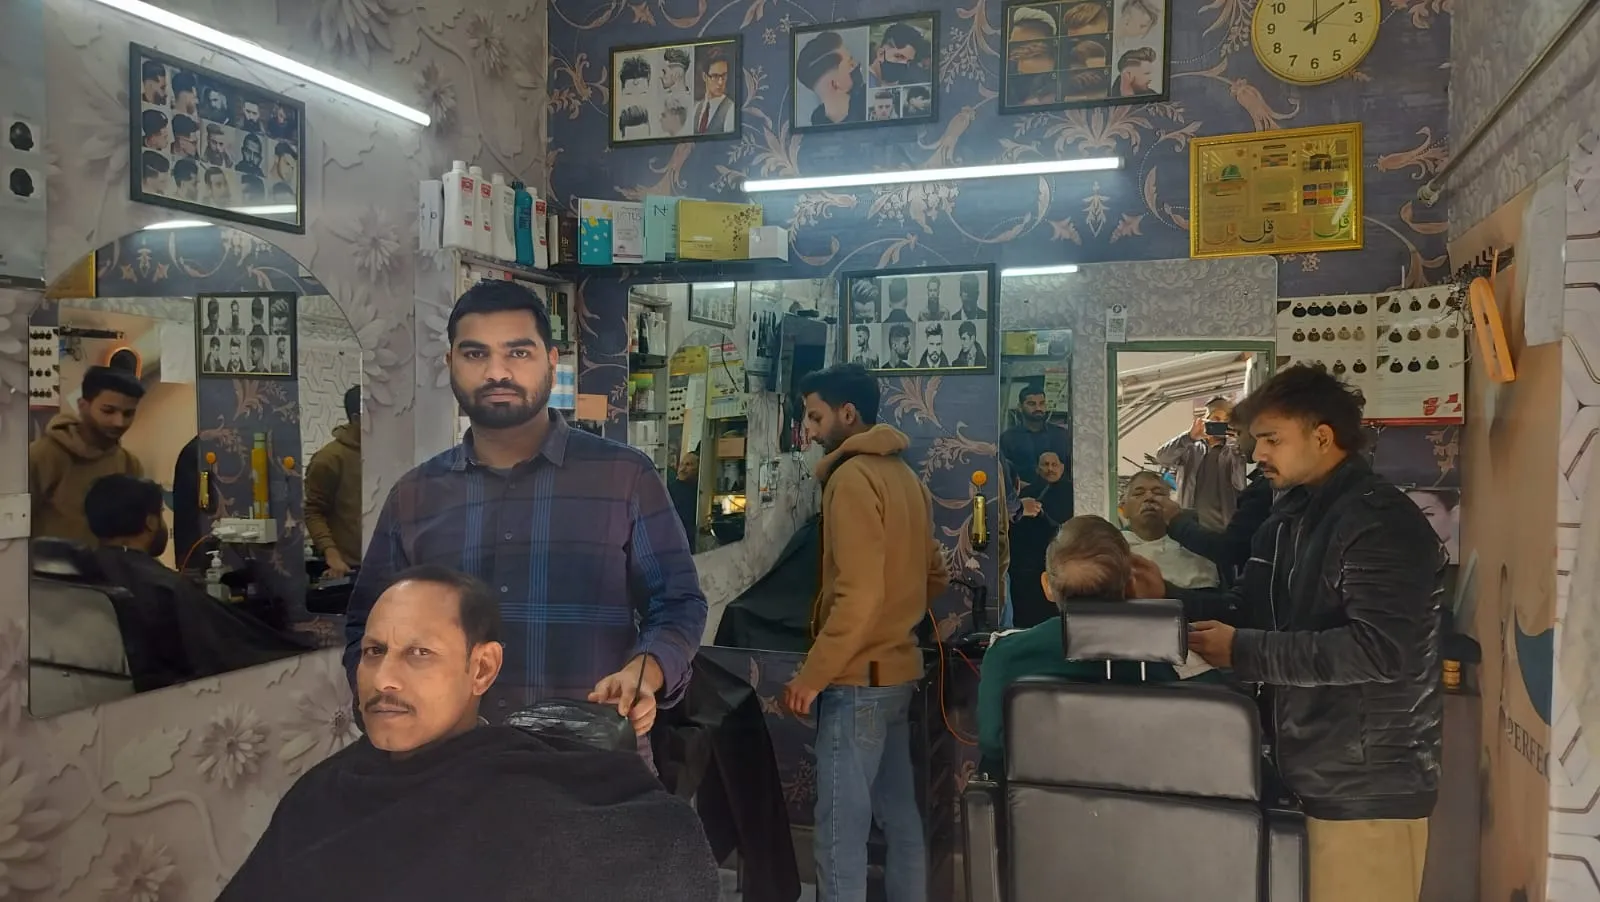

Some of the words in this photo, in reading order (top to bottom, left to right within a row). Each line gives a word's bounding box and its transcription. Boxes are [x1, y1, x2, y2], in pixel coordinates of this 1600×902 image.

[1271, 2, 1286, 14] 10
[1354, 12, 1363, 23] 3
[1267, 24, 1275, 34] 9
[1348, 33, 1357, 44] 4
[1273, 42, 1282, 54] 8
[1289, 55, 1298, 66] 7
[1333, 50, 1341, 61] 5
[1310, 58, 1319, 69] 6
